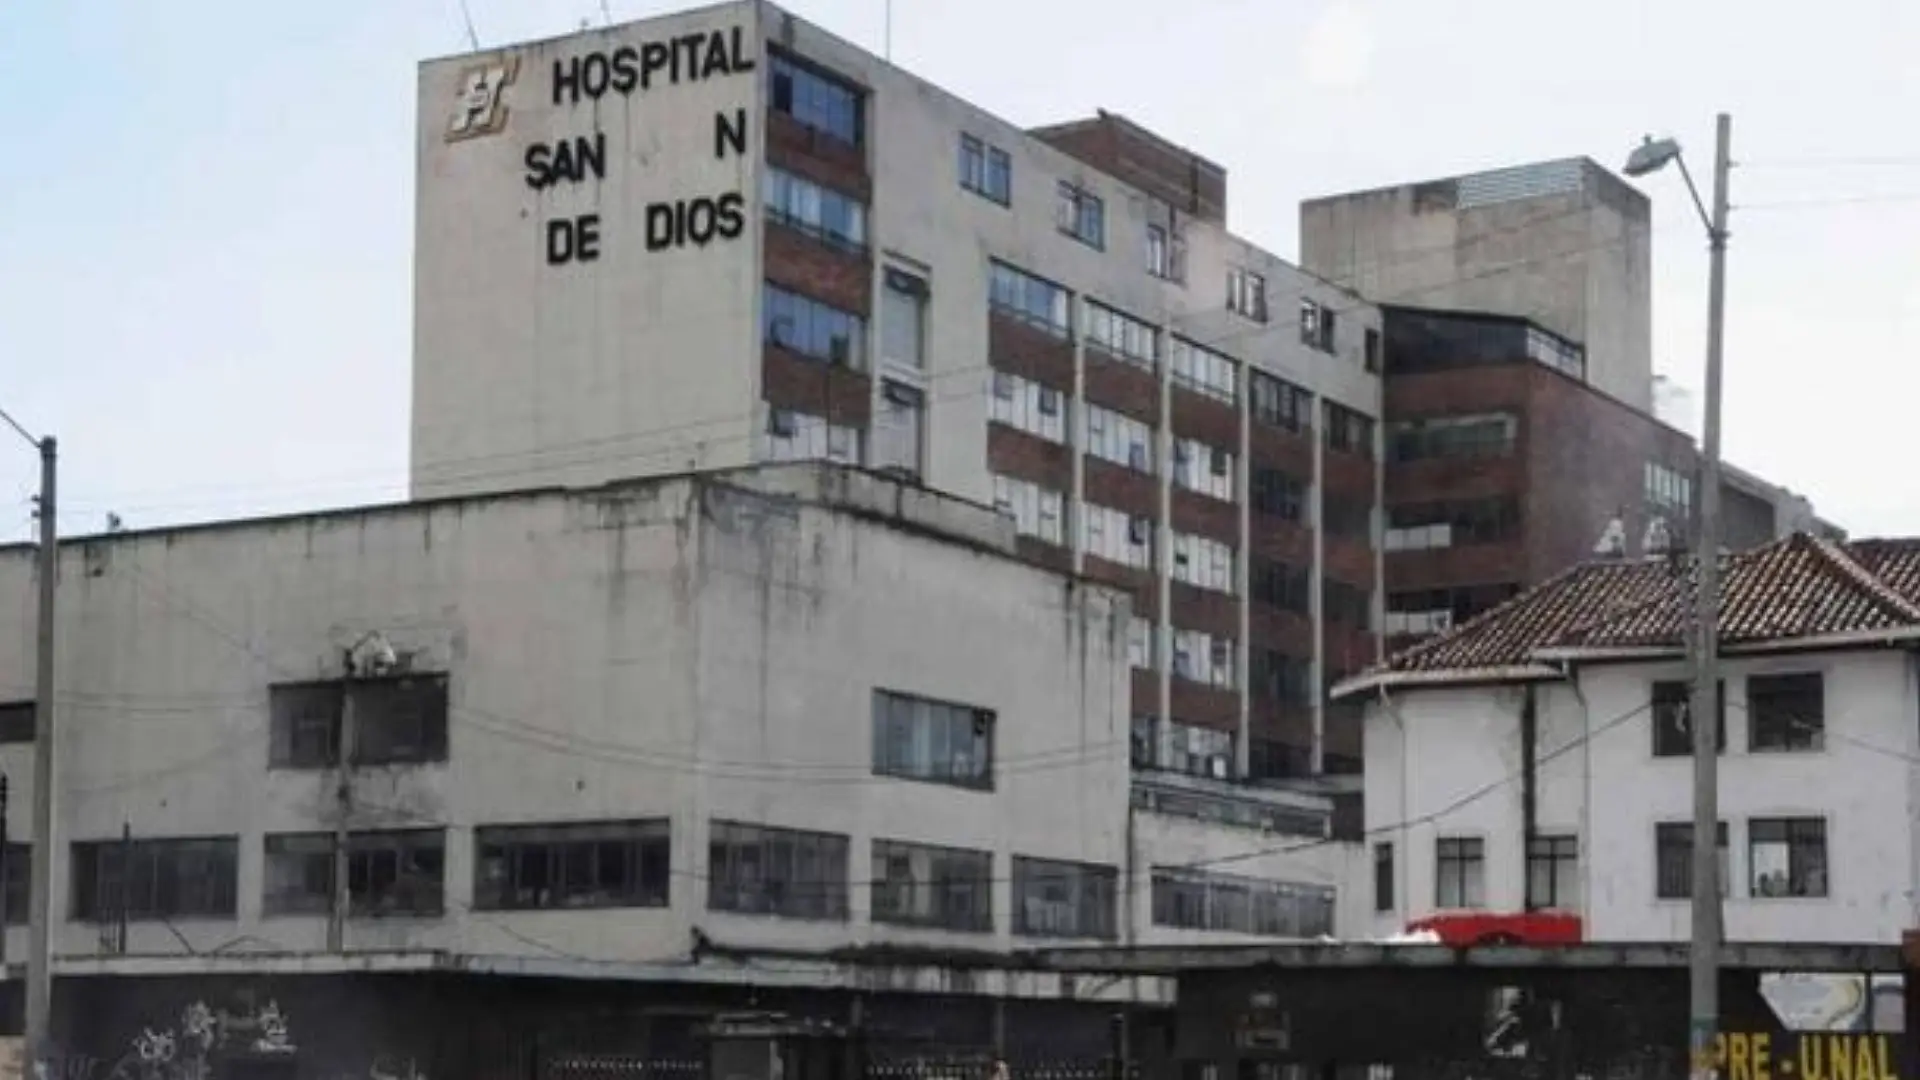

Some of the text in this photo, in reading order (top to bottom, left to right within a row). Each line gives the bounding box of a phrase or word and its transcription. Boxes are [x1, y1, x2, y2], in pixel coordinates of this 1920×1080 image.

[552, 26, 756, 105] HOSPITAL
[524, 108, 746, 191] SAN N
[547, 192, 745, 266] DE DIOS
